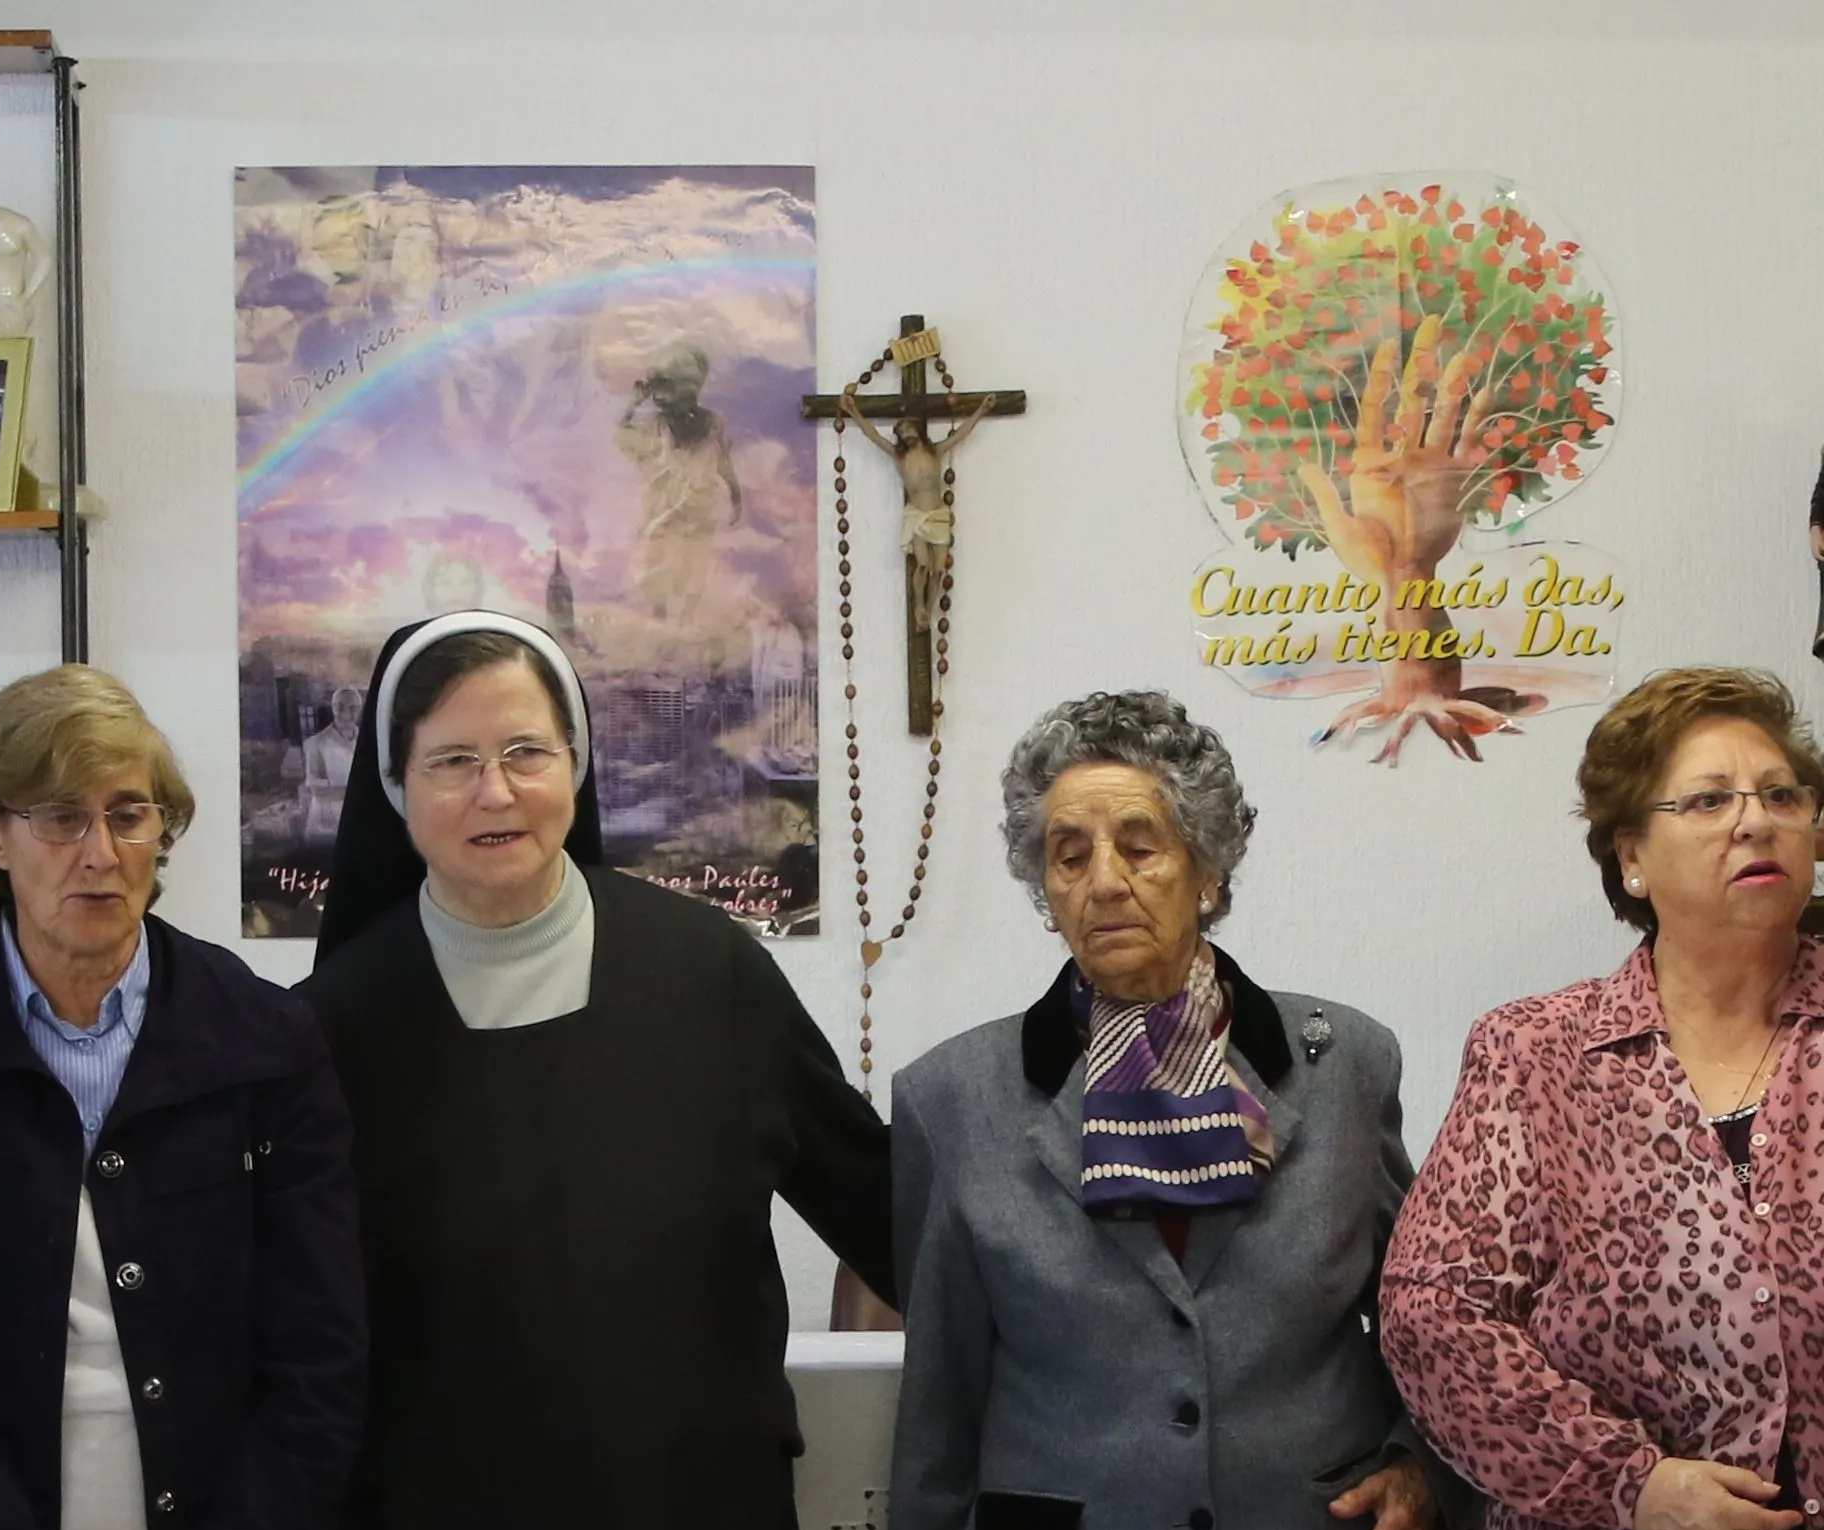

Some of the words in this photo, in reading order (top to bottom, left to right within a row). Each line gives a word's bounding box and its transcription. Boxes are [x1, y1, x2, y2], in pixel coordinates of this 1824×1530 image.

[1190, 566, 1381, 618] Cuanto
[1395, 561, 1509, 610] más
[1523, 553, 1624, 612] das,
[1204, 618, 1318, 666] más
[1332, 613, 1496, 662] tienes.
[1514, 608, 1611, 658] Da.
[703, 865, 780, 890] Paúles
[710, 888, 792, 912] obres"
